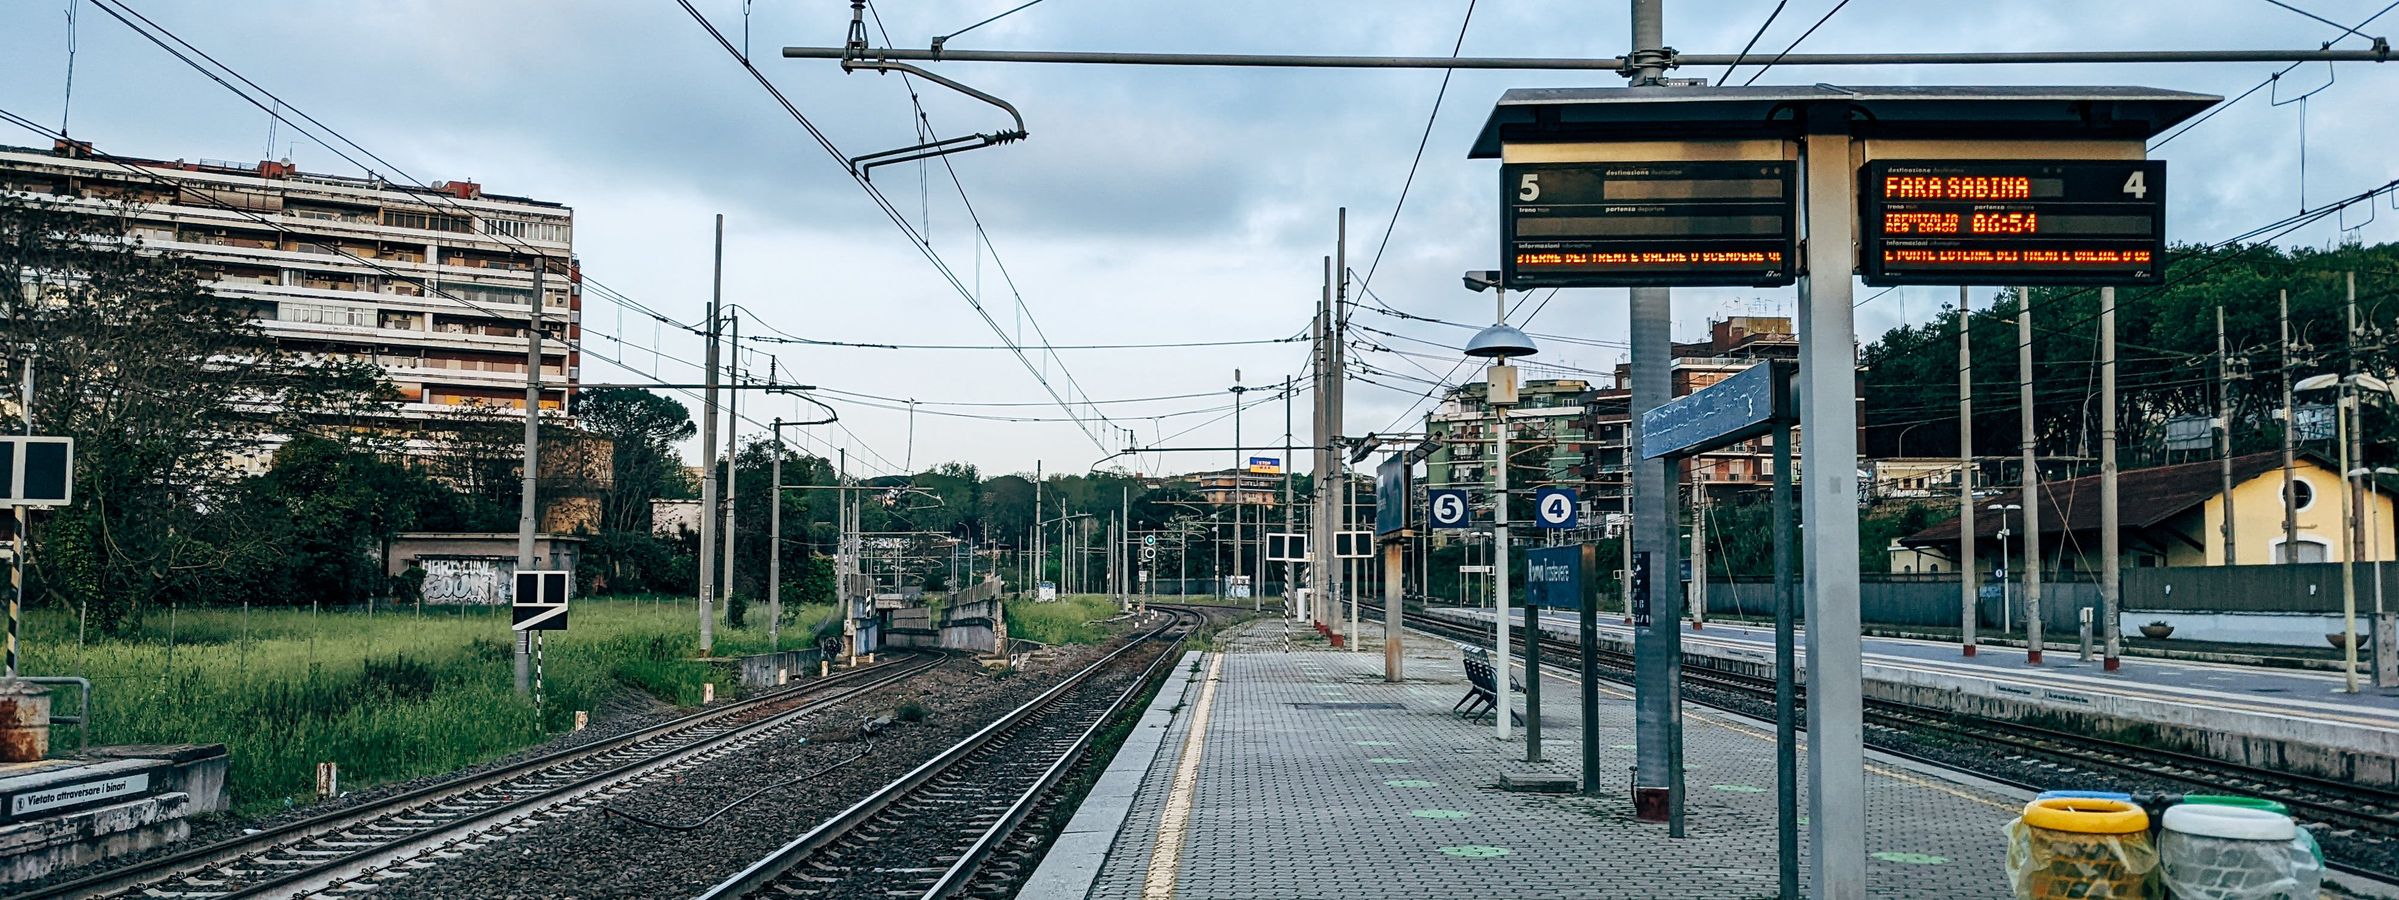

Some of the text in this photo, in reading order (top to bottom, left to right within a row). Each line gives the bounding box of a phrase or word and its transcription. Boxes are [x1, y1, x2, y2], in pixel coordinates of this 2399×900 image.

[1519, 173, 1540, 202] 5
[1886, 177, 2029, 198] FARA SABINA
[2123, 170, 2147, 199] 4
[1973, 213, 2036, 233] 06:54
[1441, 498, 1456, 520] 5
[1547, 499, 1565, 518] 4
[1528, 559, 1544, 582] Roma
[28, 780, 126, 805] Vietato attraversare i binari
